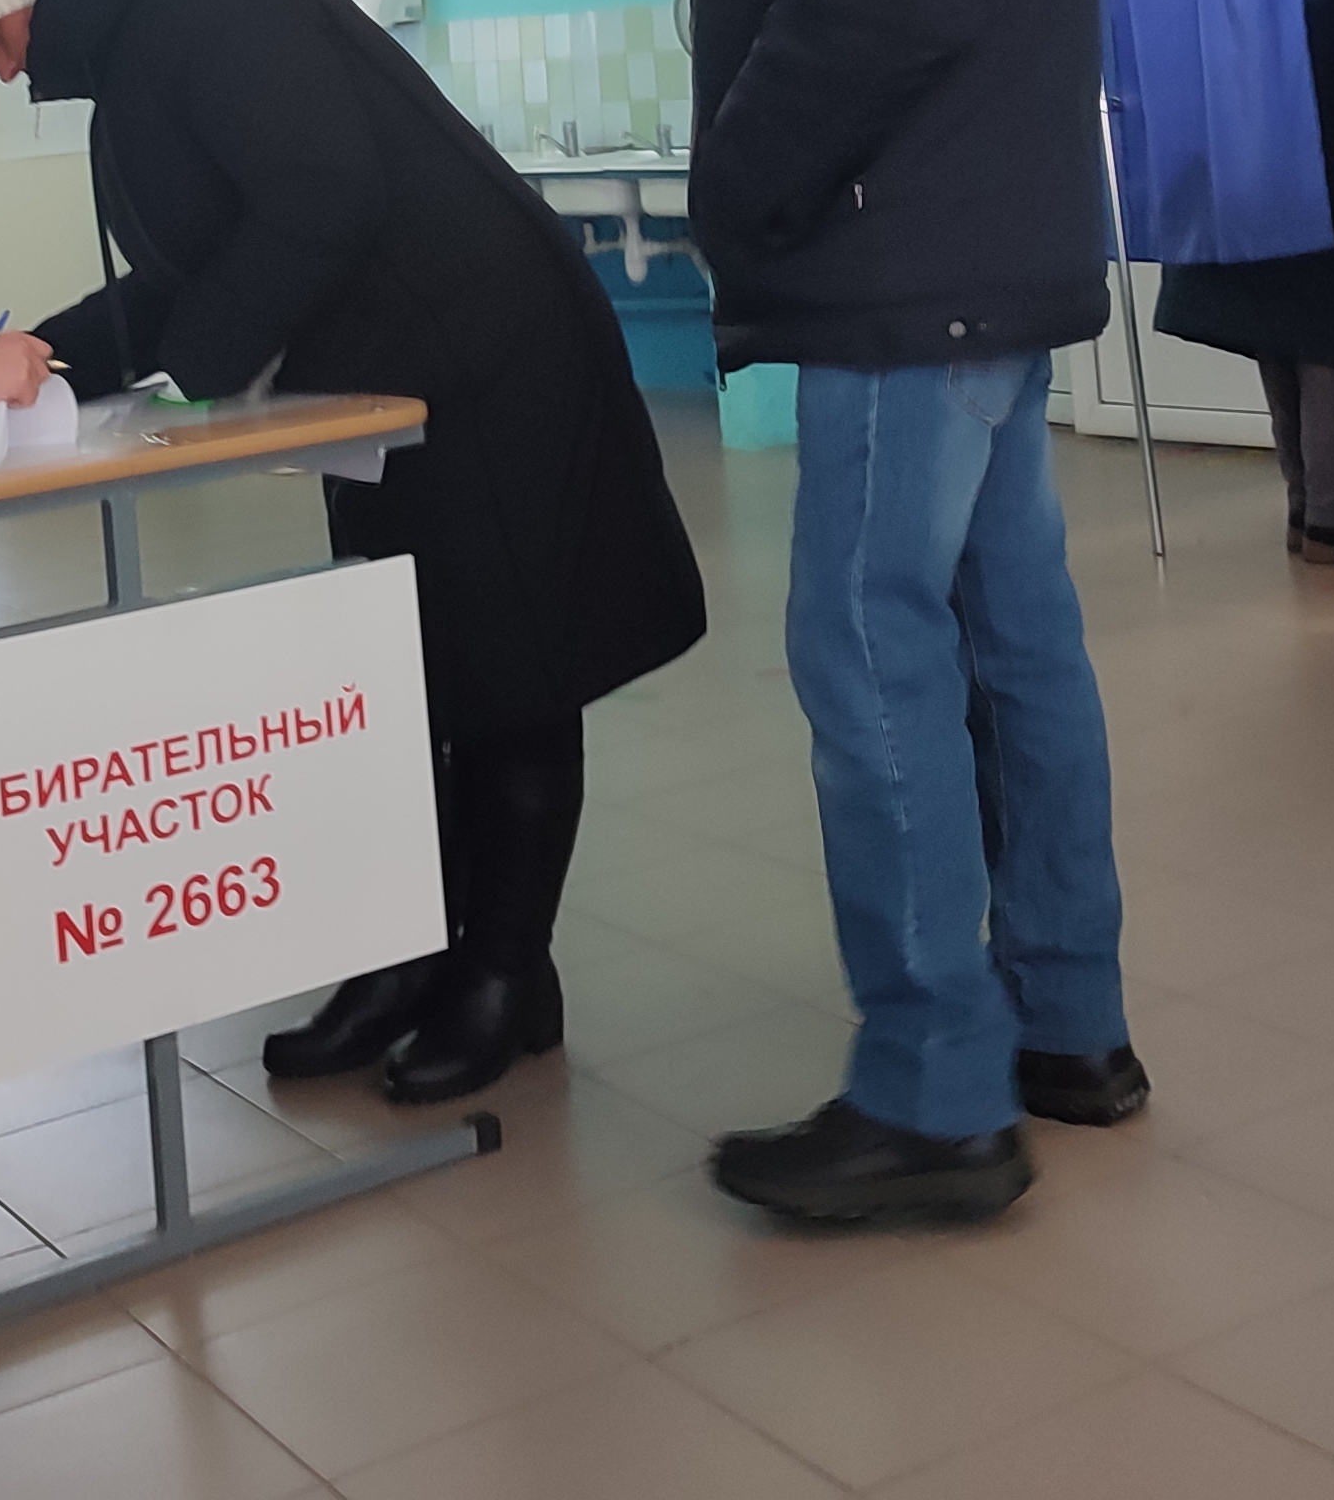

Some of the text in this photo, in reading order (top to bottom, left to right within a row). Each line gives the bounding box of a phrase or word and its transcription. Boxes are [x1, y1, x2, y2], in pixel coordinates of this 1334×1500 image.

[46, 773, 275, 867] УЧАСТОК
[55, 856, 282, 963] № 2663
